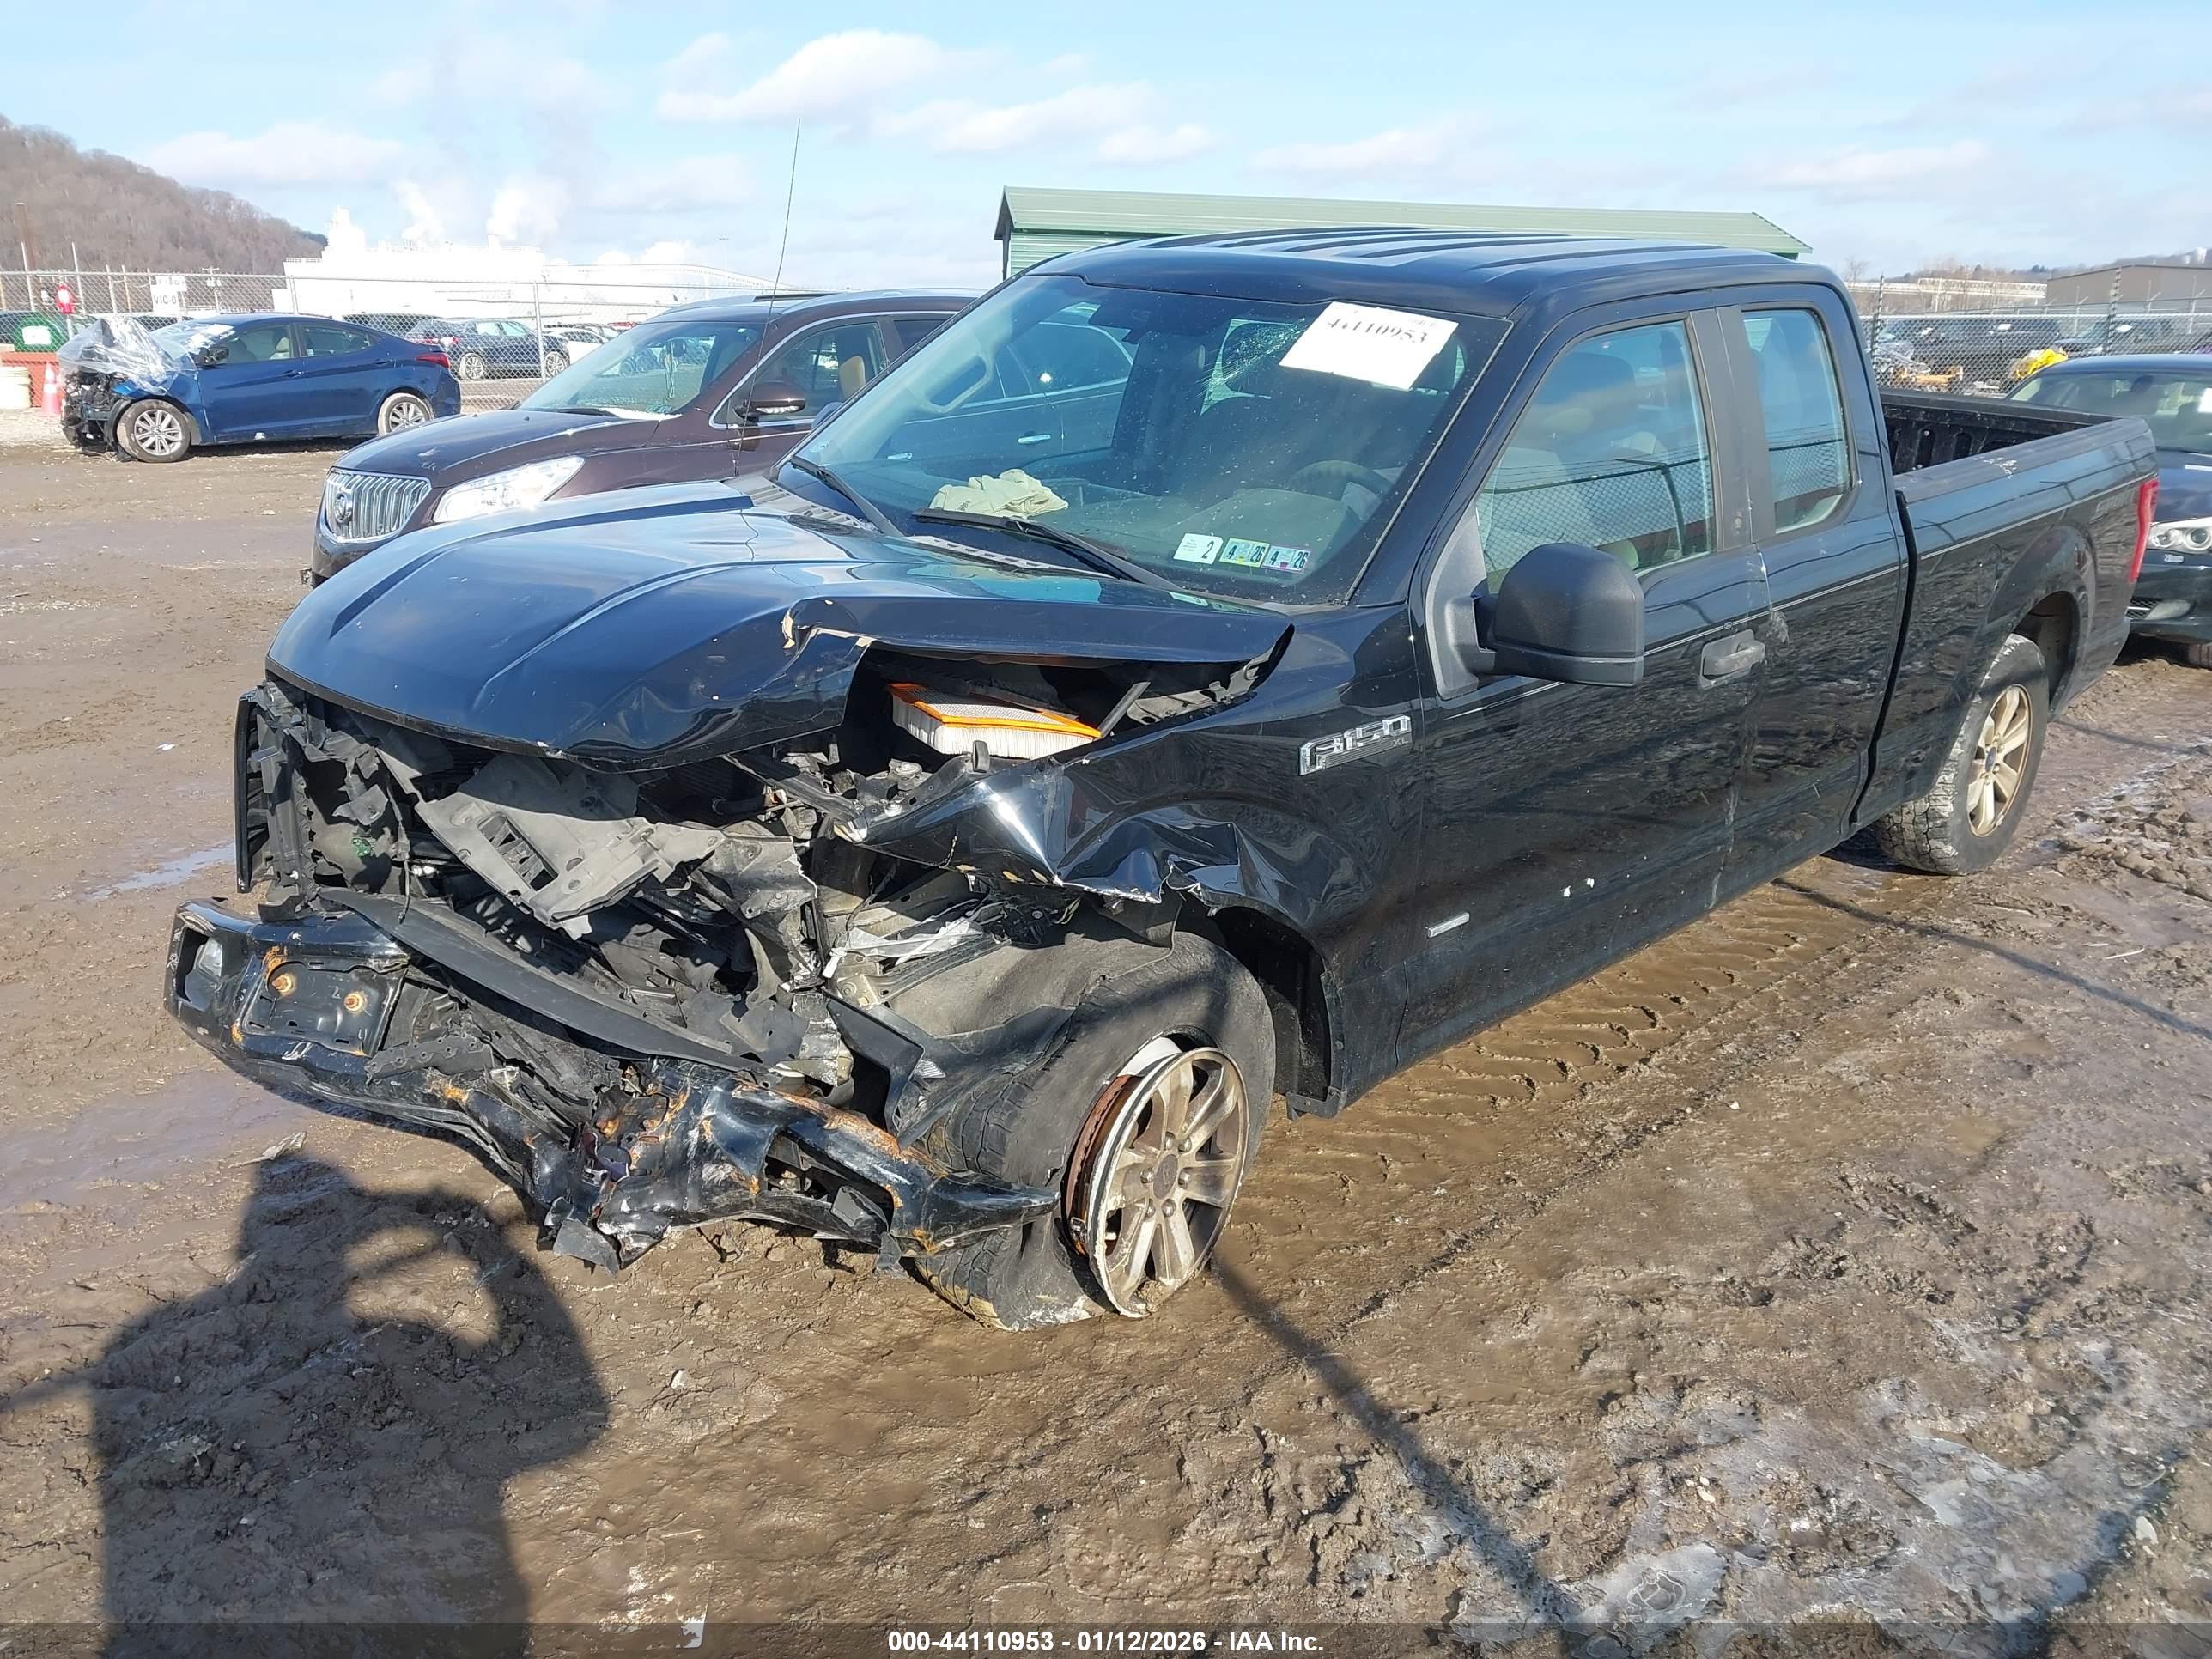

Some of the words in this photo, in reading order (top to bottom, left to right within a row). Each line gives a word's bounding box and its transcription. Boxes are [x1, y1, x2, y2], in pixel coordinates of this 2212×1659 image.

[1200, 540, 1215, 560] 2
[1228, 545, 1237, 559] 4
[1249, 546, 1266, 563] 26
[1270, 550, 1279, 566] 4
[1293, 551, 1309, 568] 26
[1393, 736, 1410, 747] XL
